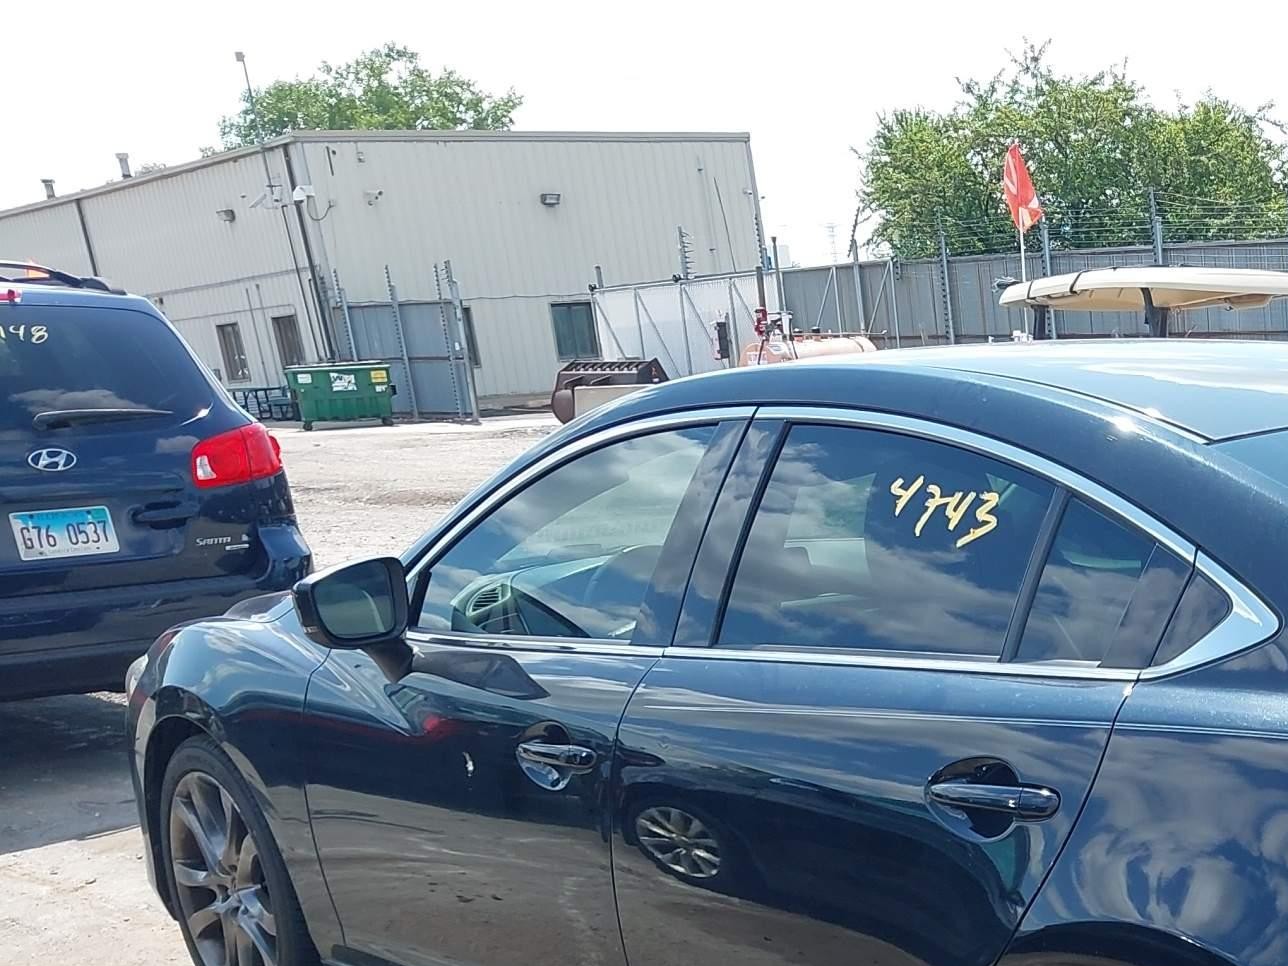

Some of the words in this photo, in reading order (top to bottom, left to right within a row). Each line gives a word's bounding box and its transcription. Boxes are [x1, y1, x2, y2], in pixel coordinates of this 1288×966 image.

[20, 525, 57, 550] G76
[66, 520, 109, 546] 0537
[890, 475, 1000, 548] 4743
